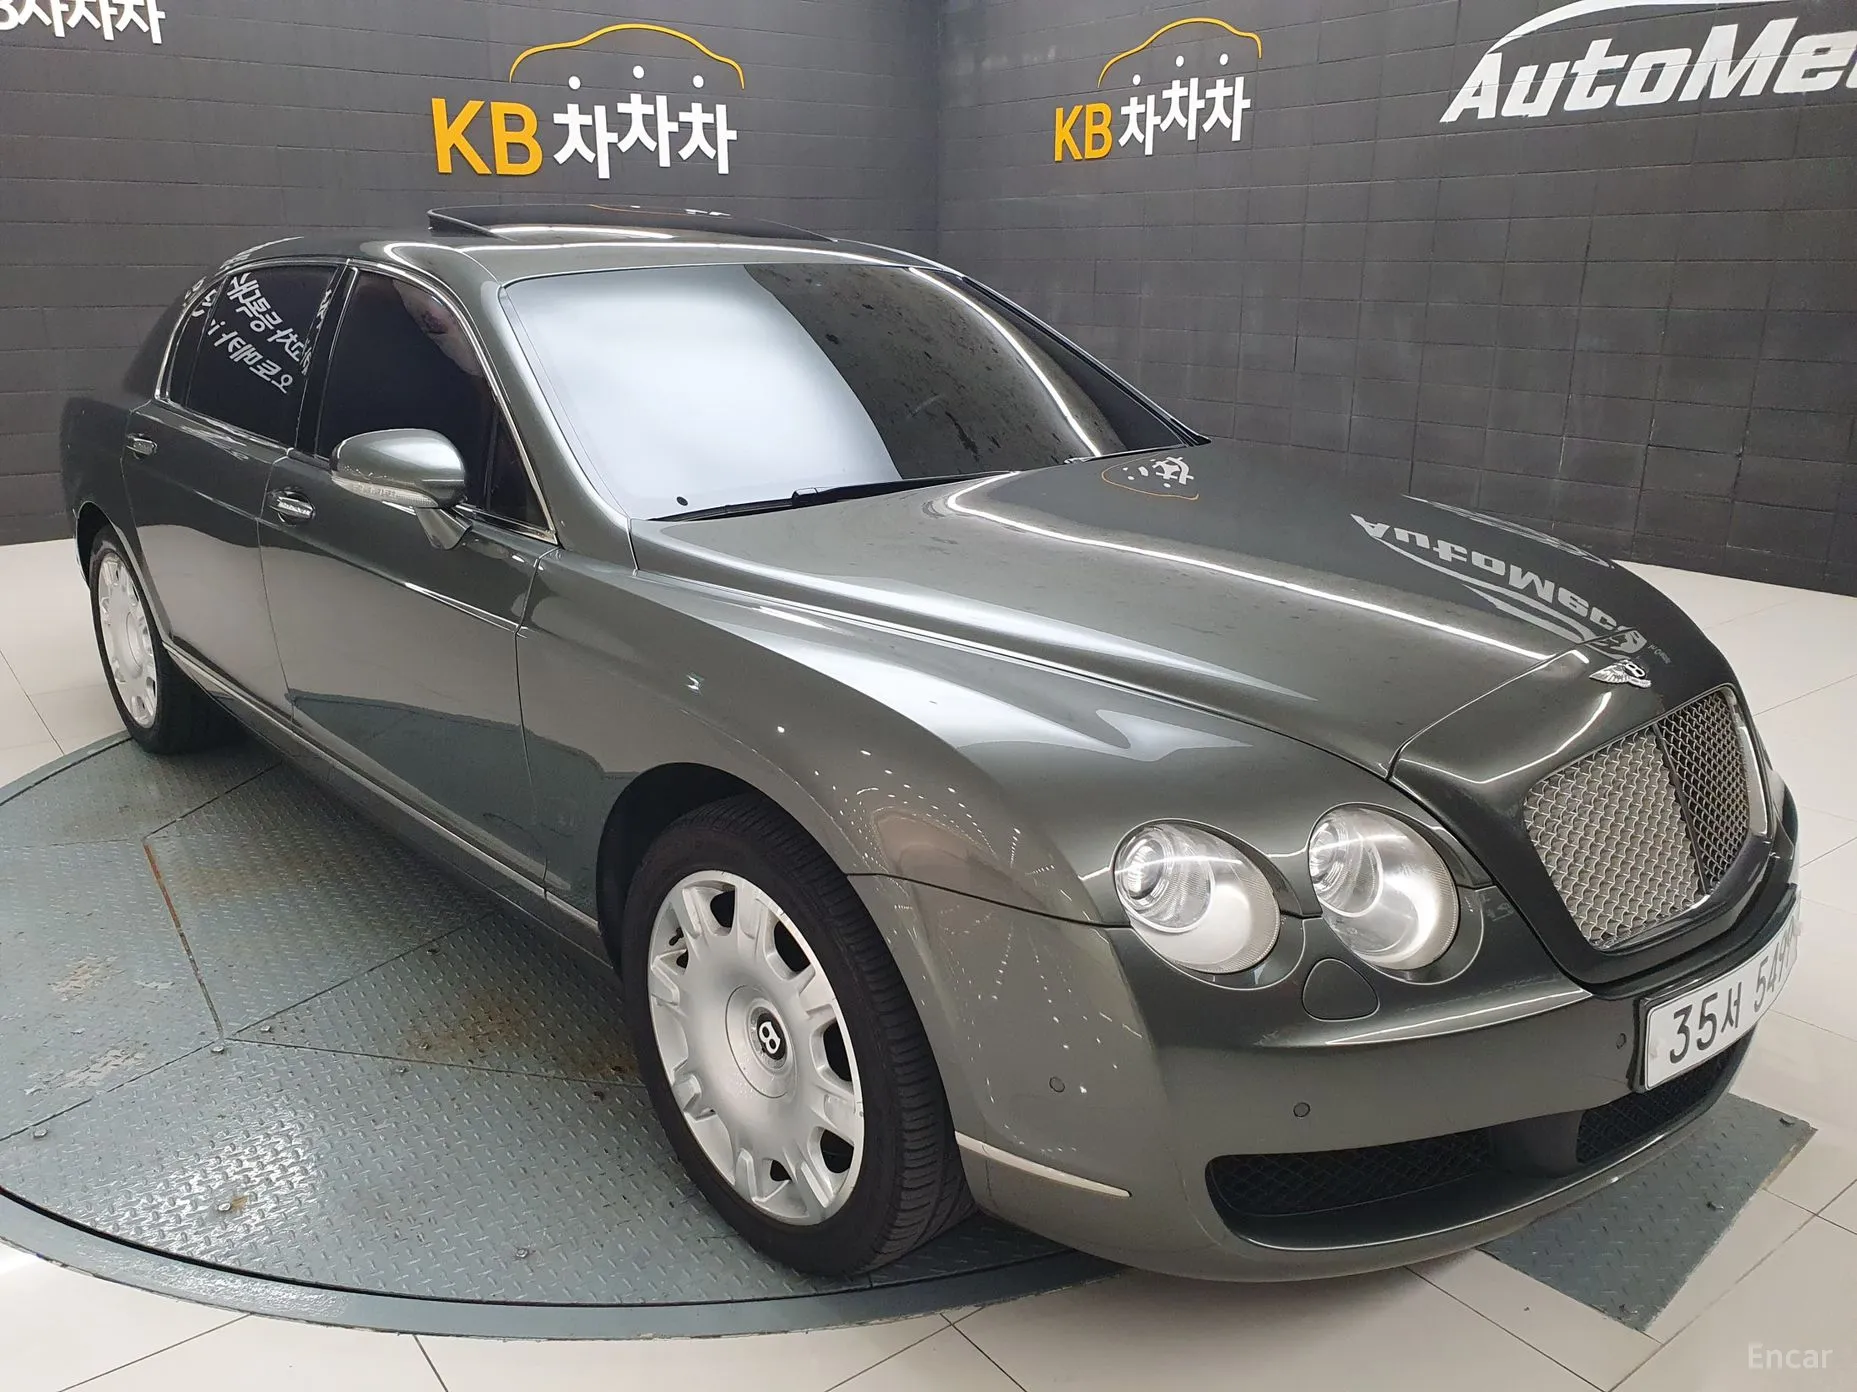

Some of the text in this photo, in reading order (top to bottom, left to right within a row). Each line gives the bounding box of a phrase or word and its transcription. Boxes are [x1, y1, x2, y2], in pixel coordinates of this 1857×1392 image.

[431, 66, 738, 180] KB 차차차
[1053, 54, 1251, 163] KB 차차차
[1439, 17, 1857, 123] AutoMe
[1669, 981, 1742, 1064] 35서
